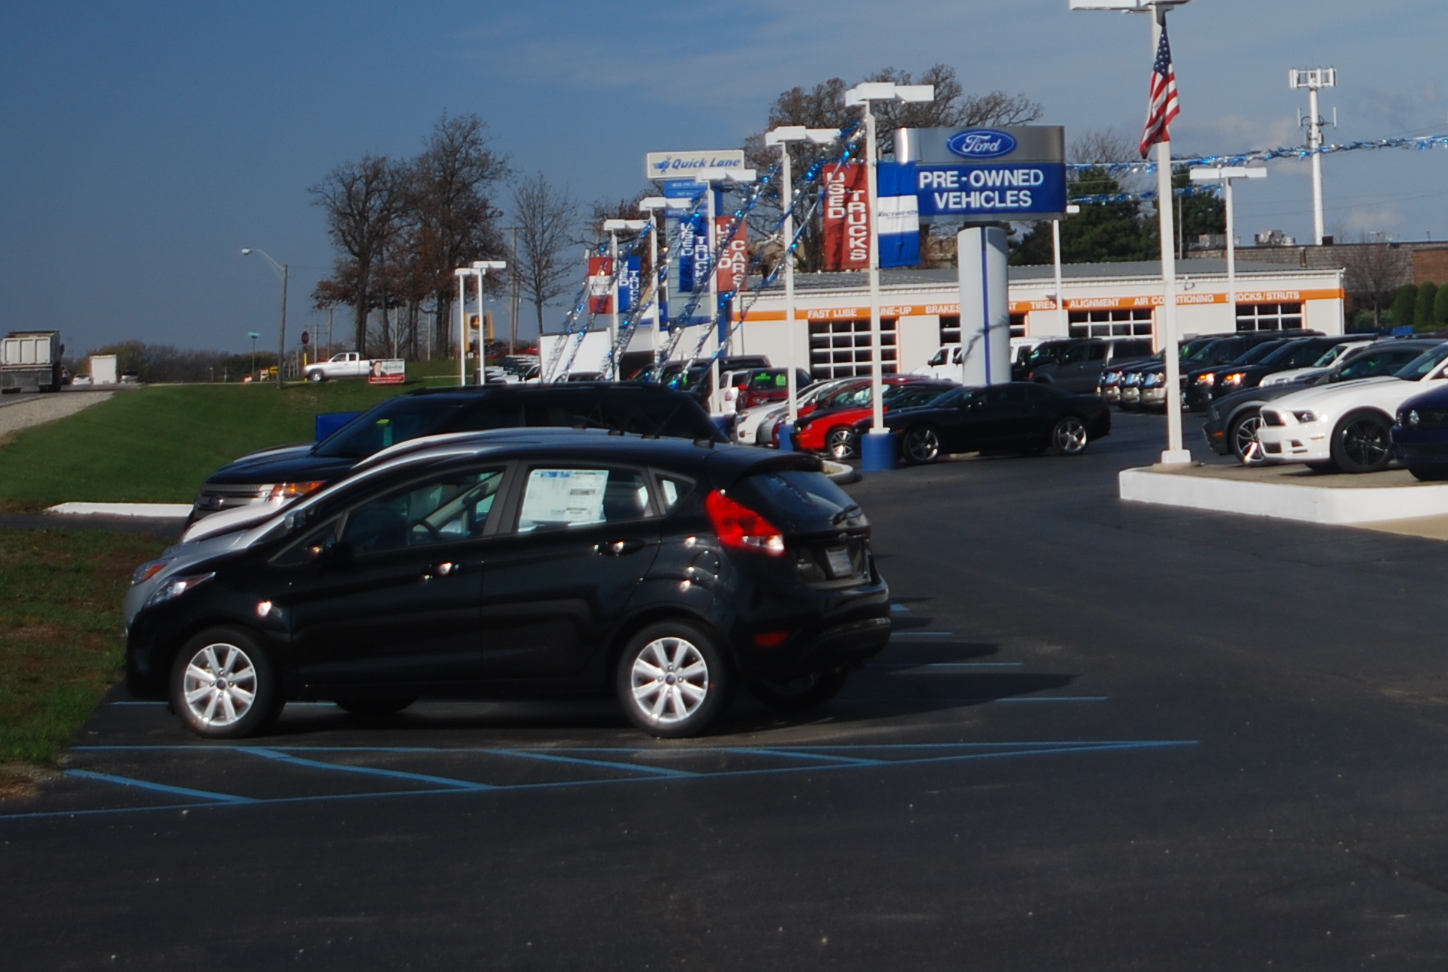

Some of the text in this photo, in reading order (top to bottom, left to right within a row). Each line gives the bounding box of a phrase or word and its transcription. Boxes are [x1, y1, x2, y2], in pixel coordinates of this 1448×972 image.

[961, 134, 1002, 153] Ford
[671, 157, 741, 170] Quick Lane
[919, 169, 1044, 189] PRE-OWNED
[826, 172, 846, 219] USED
[934, 190, 1032, 209] VEHICLES
[847, 189, 868, 261] TRUCKS
[731, 240, 746, 286] CARS
[807, 304, 960, 319] FAST LUBE UNE-UP BRAKES
[1030, 301, 1057, 310] TIRES
[1069, 298, 1120, 308] ALIGNMENT
[1134, 297, 1149, 306] AIR
[1151, 294, 1215, 305] COITIONING
